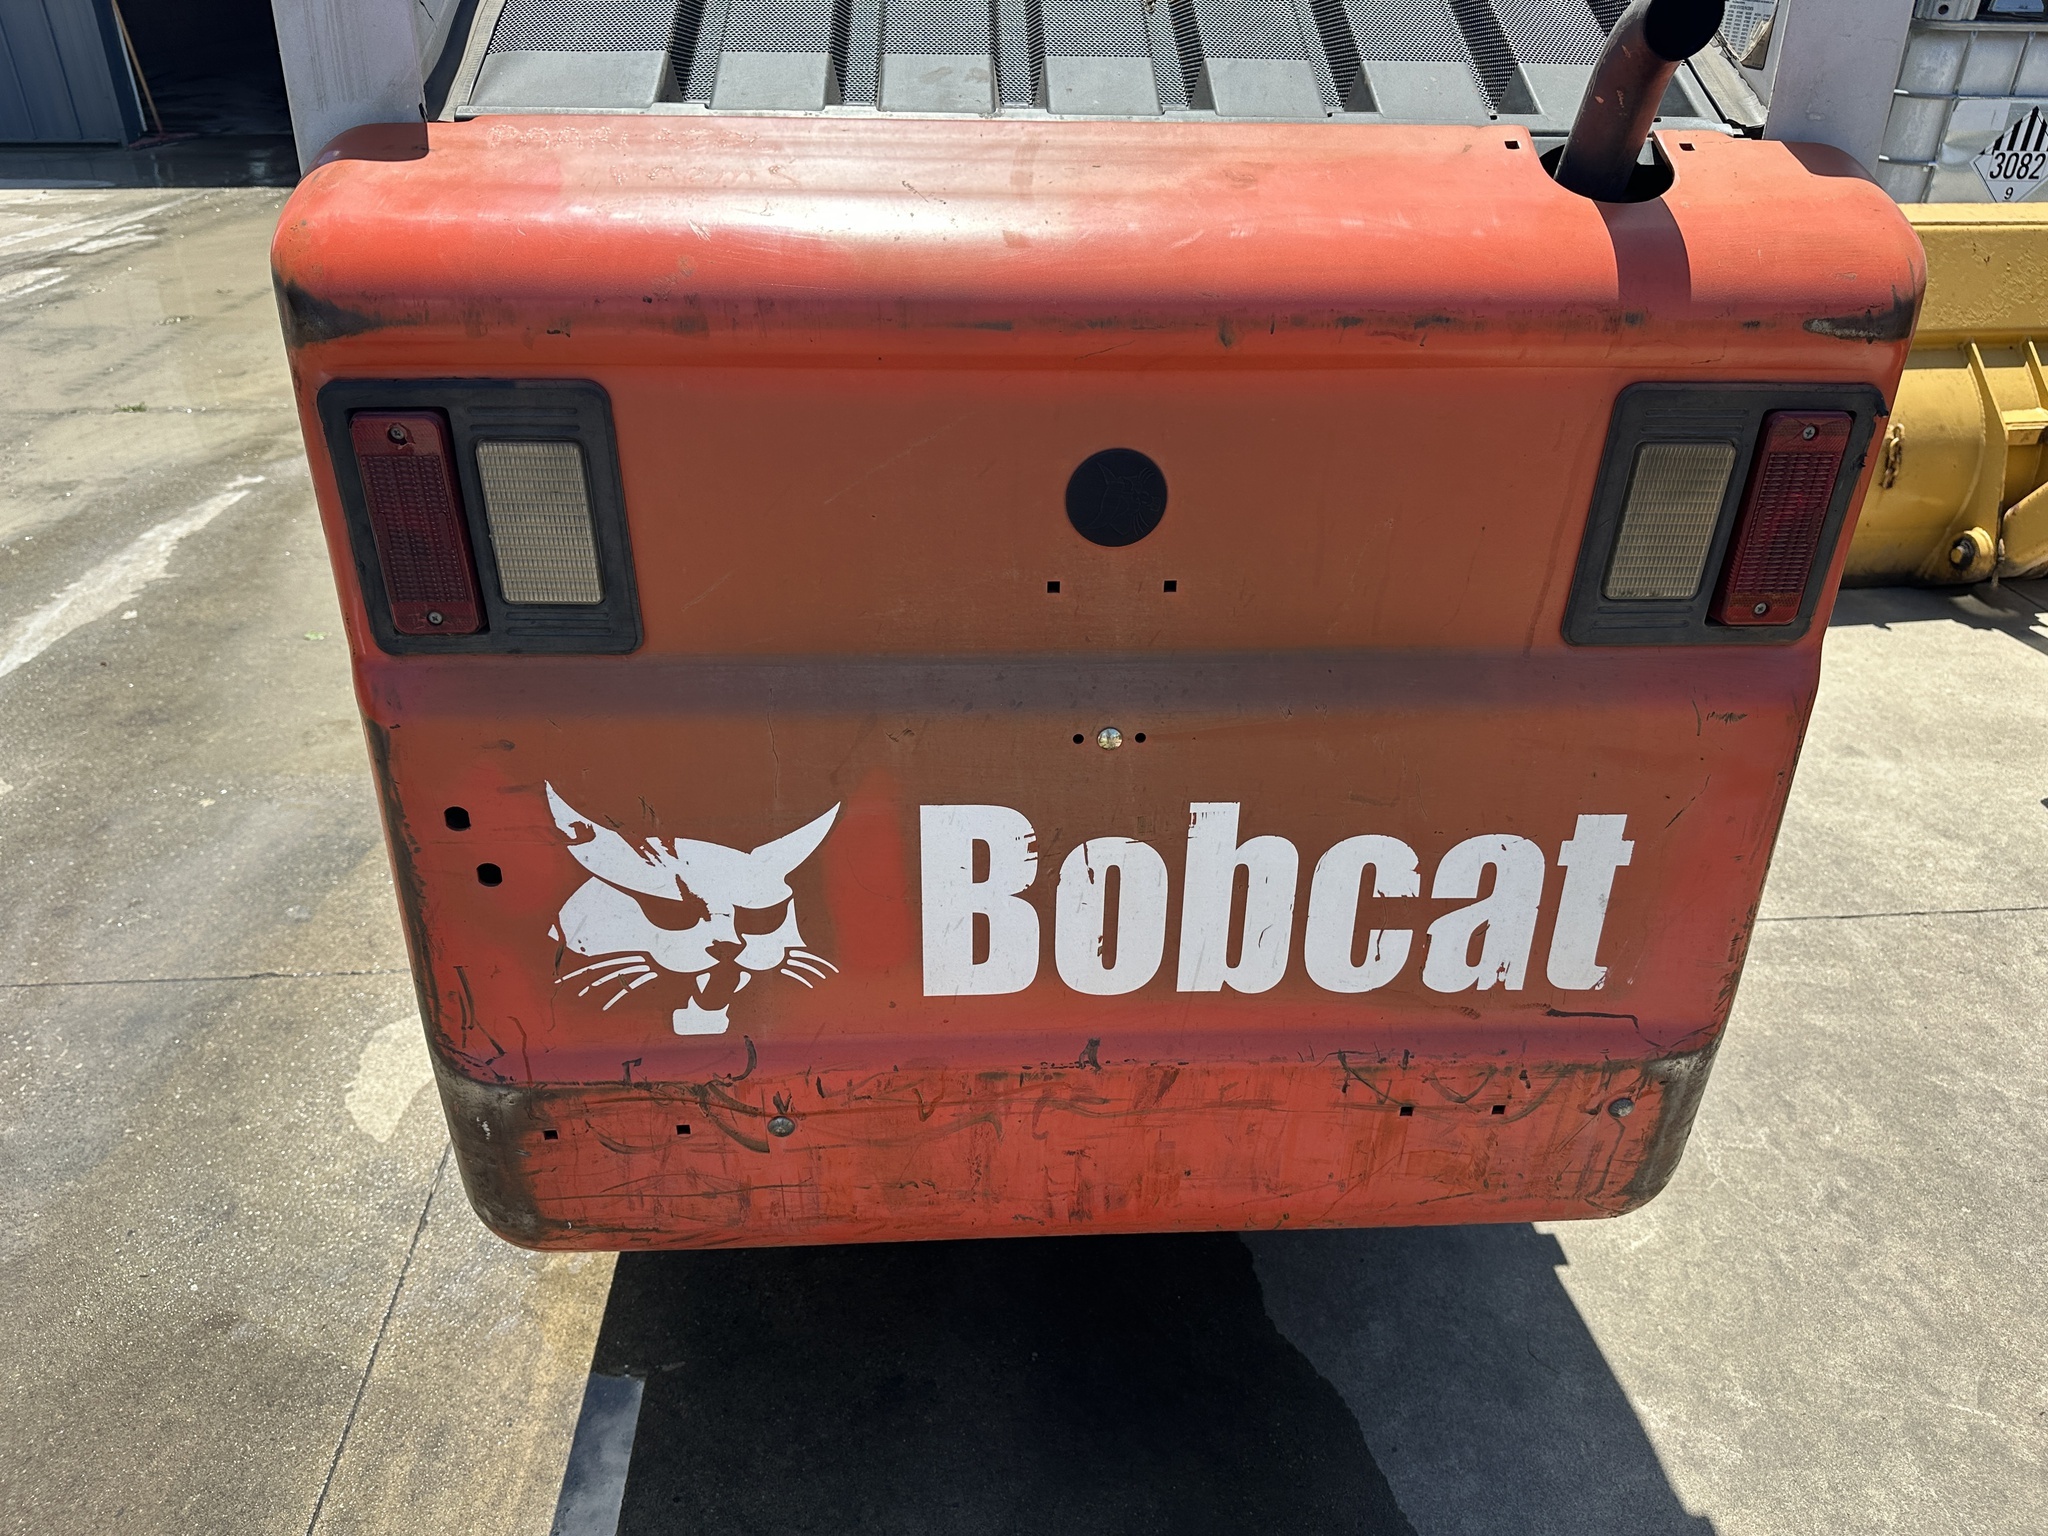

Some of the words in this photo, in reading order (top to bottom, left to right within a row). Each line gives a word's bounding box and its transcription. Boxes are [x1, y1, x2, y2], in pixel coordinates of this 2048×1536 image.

[1989, 152, 2047, 180] 3082
[2004, 187, 2014, 200] 9
[920, 802, 1634, 996] Bobcat
